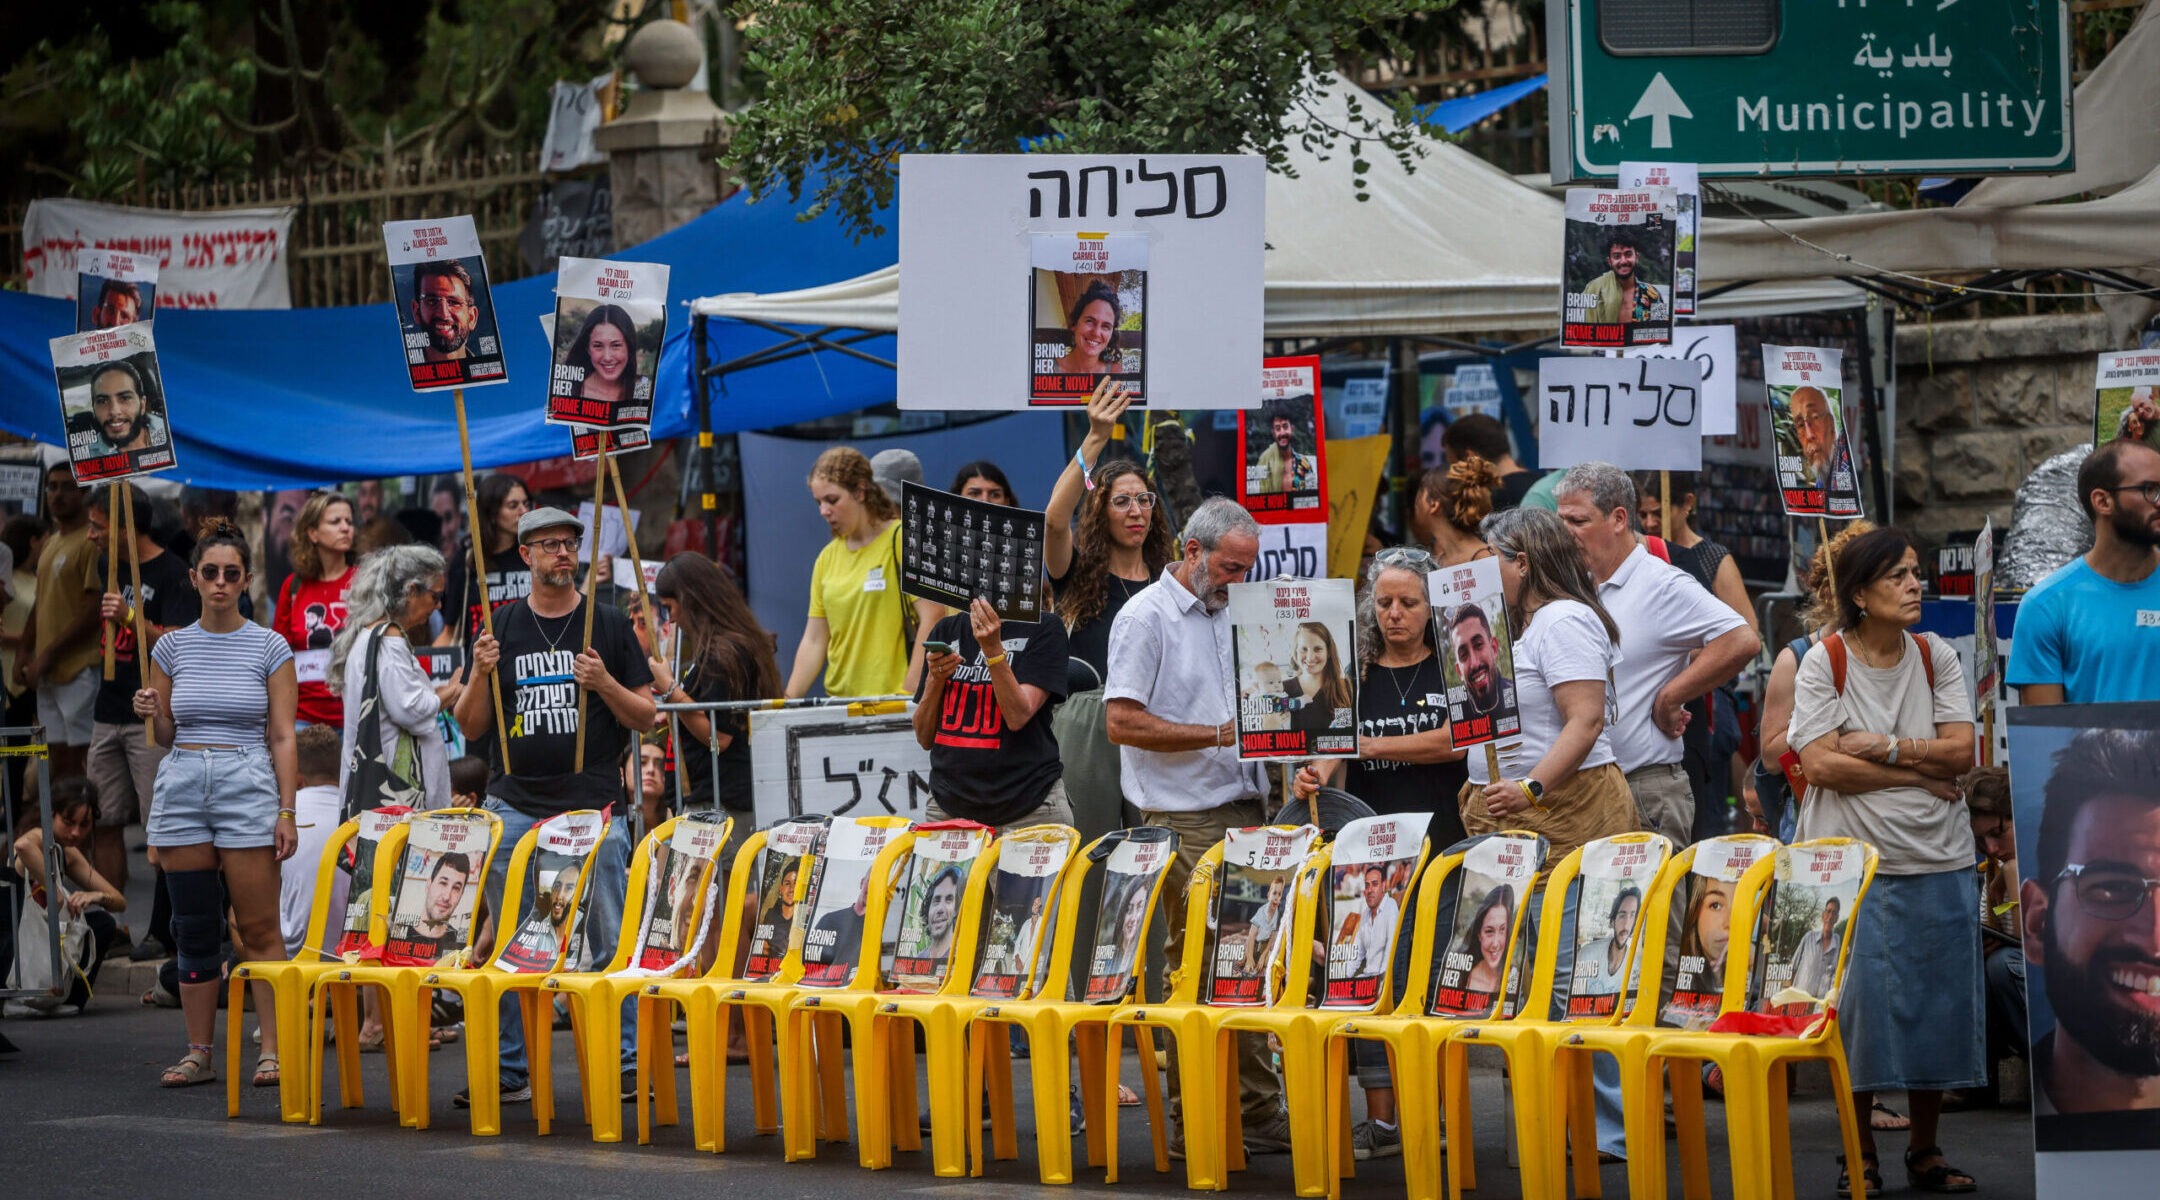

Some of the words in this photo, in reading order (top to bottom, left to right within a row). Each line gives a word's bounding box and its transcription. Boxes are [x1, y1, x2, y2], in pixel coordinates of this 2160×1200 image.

[1853, 32, 1953, 78] بلدية
[1737, 92, 2046, 138] Municipality
[1028, 158, 1227, 219] סליחה
[1589, 203, 1609, 212] HERSH
[1609, 203, 1657, 212] GOLDBERG-POLIN
[412, 238, 430, 248] ALMOG
[1079, 241, 1088, 250] גת
[1089, 241, 1103, 250] כרמל
[1072, 251, 1097, 261] CARMEL
[1097, 251, 1109, 261] GAT
[597, 277, 618, 288] NAAMA
[620, 279, 634, 289] LEVY
[1567, 293, 1597, 308] BRING
[1566, 308, 1585, 323] HIM
[405, 331, 430, 348] BRING
[1565, 324, 1594, 340] HOME
[1595, 324, 1625, 340] NOW!
[80, 345, 97, 355] MATAN
[98, 351, 110, 361] (24)
[407, 348, 425, 364] HIM
[1034, 343, 1065, 359] BRING
[411, 363, 437, 381] HOME
[436, 360, 463, 380] NOW!
[554, 364, 585, 382] BRING
[1034, 359, 1055, 374] HER
[552, 381, 572, 396] HER
[1034, 375, 1063, 391] HOME
[1065, 374, 1094, 391] NOW!
[1548, 360, 1697, 428] סליחה
[551, 397, 580, 415] HOME
[581, 400, 611, 420] NOW!
[70, 429, 98, 446] BRING
[71, 446, 90, 461] HIM
[75, 455, 102, 475] HOME
[102, 452, 130, 472] NOW!
[1778, 456, 1803, 472] BRING
[1780, 472, 1797, 488] HIM
[1783, 489, 1806, 506] HOME
[1276, 587, 1290, 597] ביבס
[1292, 587, 1307, 596] שירי
[1274, 598, 1291, 608] SHIRI
[1291, 597, 1311, 608] BIBAS
[1276, 609, 1295, 619] (33)
[515, 650, 575, 681] מנצחים
[515, 683, 576, 714] כשכולם
[1448, 686, 1468, 703] BRING
[1242, 698, 1274, 716] BRING
[1450, 703, 1464, 721] HIM
[523, 707, 579, 736] חוזרים
[1242, 715, 1263, 732] HER
[1452, 721, 1472, 740] HOME
[1472, 714, 1493, 736] NOW!
[1242, 732, 1273, 750] HOME
[1275, 730, 1307, 749] NOW!
[549, 836, 572, 847] MATAN
[1368, 836, 1376, 846] ELI
[1376, 834, 1396, 845] SHARABI
[1246, 851, 1256, 866] 5
[1265, 846, 1279, 856] ARIEL
[1369, 847, 1385, 858] (52)
[1498, 854, 1514, 864] NAAMA
[1727, 858, 1739, 868] AGAM
[395, 913, 421, 926] BRING
[526, 921, 551, 934] BRING
[652, 918, 673, 934] BRING
[391, 925, 409, 939] HIM
[518, 933, 539, 946] HIM
[648, 932, 663, 947] HIM
[756, 924, 775, 940] BRING
[807, 928, 837, 945] BRING
[900, 928, 922, 942] BRING
[388, 940, 413, 954] HOME
[414, 943, 437, 958] NOW!
[752, 939, 764, 955] HIM
[804, 944, 823, 962] HIM
[899, 941, 912, 957] HIM
[986, 944, 1006, 958] BRING
[1095, 945, 1115, 959] BRING
[1218, 944, 1245, 961] BRING
[1330, 944, 1358, 961] BRING
[750, 957, 768, 973] HOME
[895, 959, 914, 974] HOME
[914, 959, 933, 974] NOW!
[1092, 960, 1105, 976] HER
[1216, 961, 1233, 977] HIM
[1446, 951, 1474, 971] BRING
[1574, 960, 1599, 977] BRING
[1679, 955, 1705, 974] BRING
[804, 963, 825, 979] HOME
[827, 962, 848, 979] NOW!
[1328, 961, 1346, 979] HIM
[1442, 969, 1460, 987] HER
[1766, 963, 1793, 980] BRING
[977, 975, 997, 990] HOME
[997, 975, 1017, 990] NOW!
[1214, 979, 1239, 996] HOME
[1239, 979, 1260, 995] NOW!
[1327, 980, 1354, 999] HOME
[1355, 977, 1377, 998] NOW!
[1572, 977, 1588, 995] HIM
[1676, 973, 1693, 990] HER
[1763, 981, 1782, 999] HIM
[1438, 988, 1464, 1008] HOME
[1466, 990, 1490, 1010] NOW!
[1569, 996, 1593, 1014] HOME
[1594, 993, 1615, 1014] NOW!
